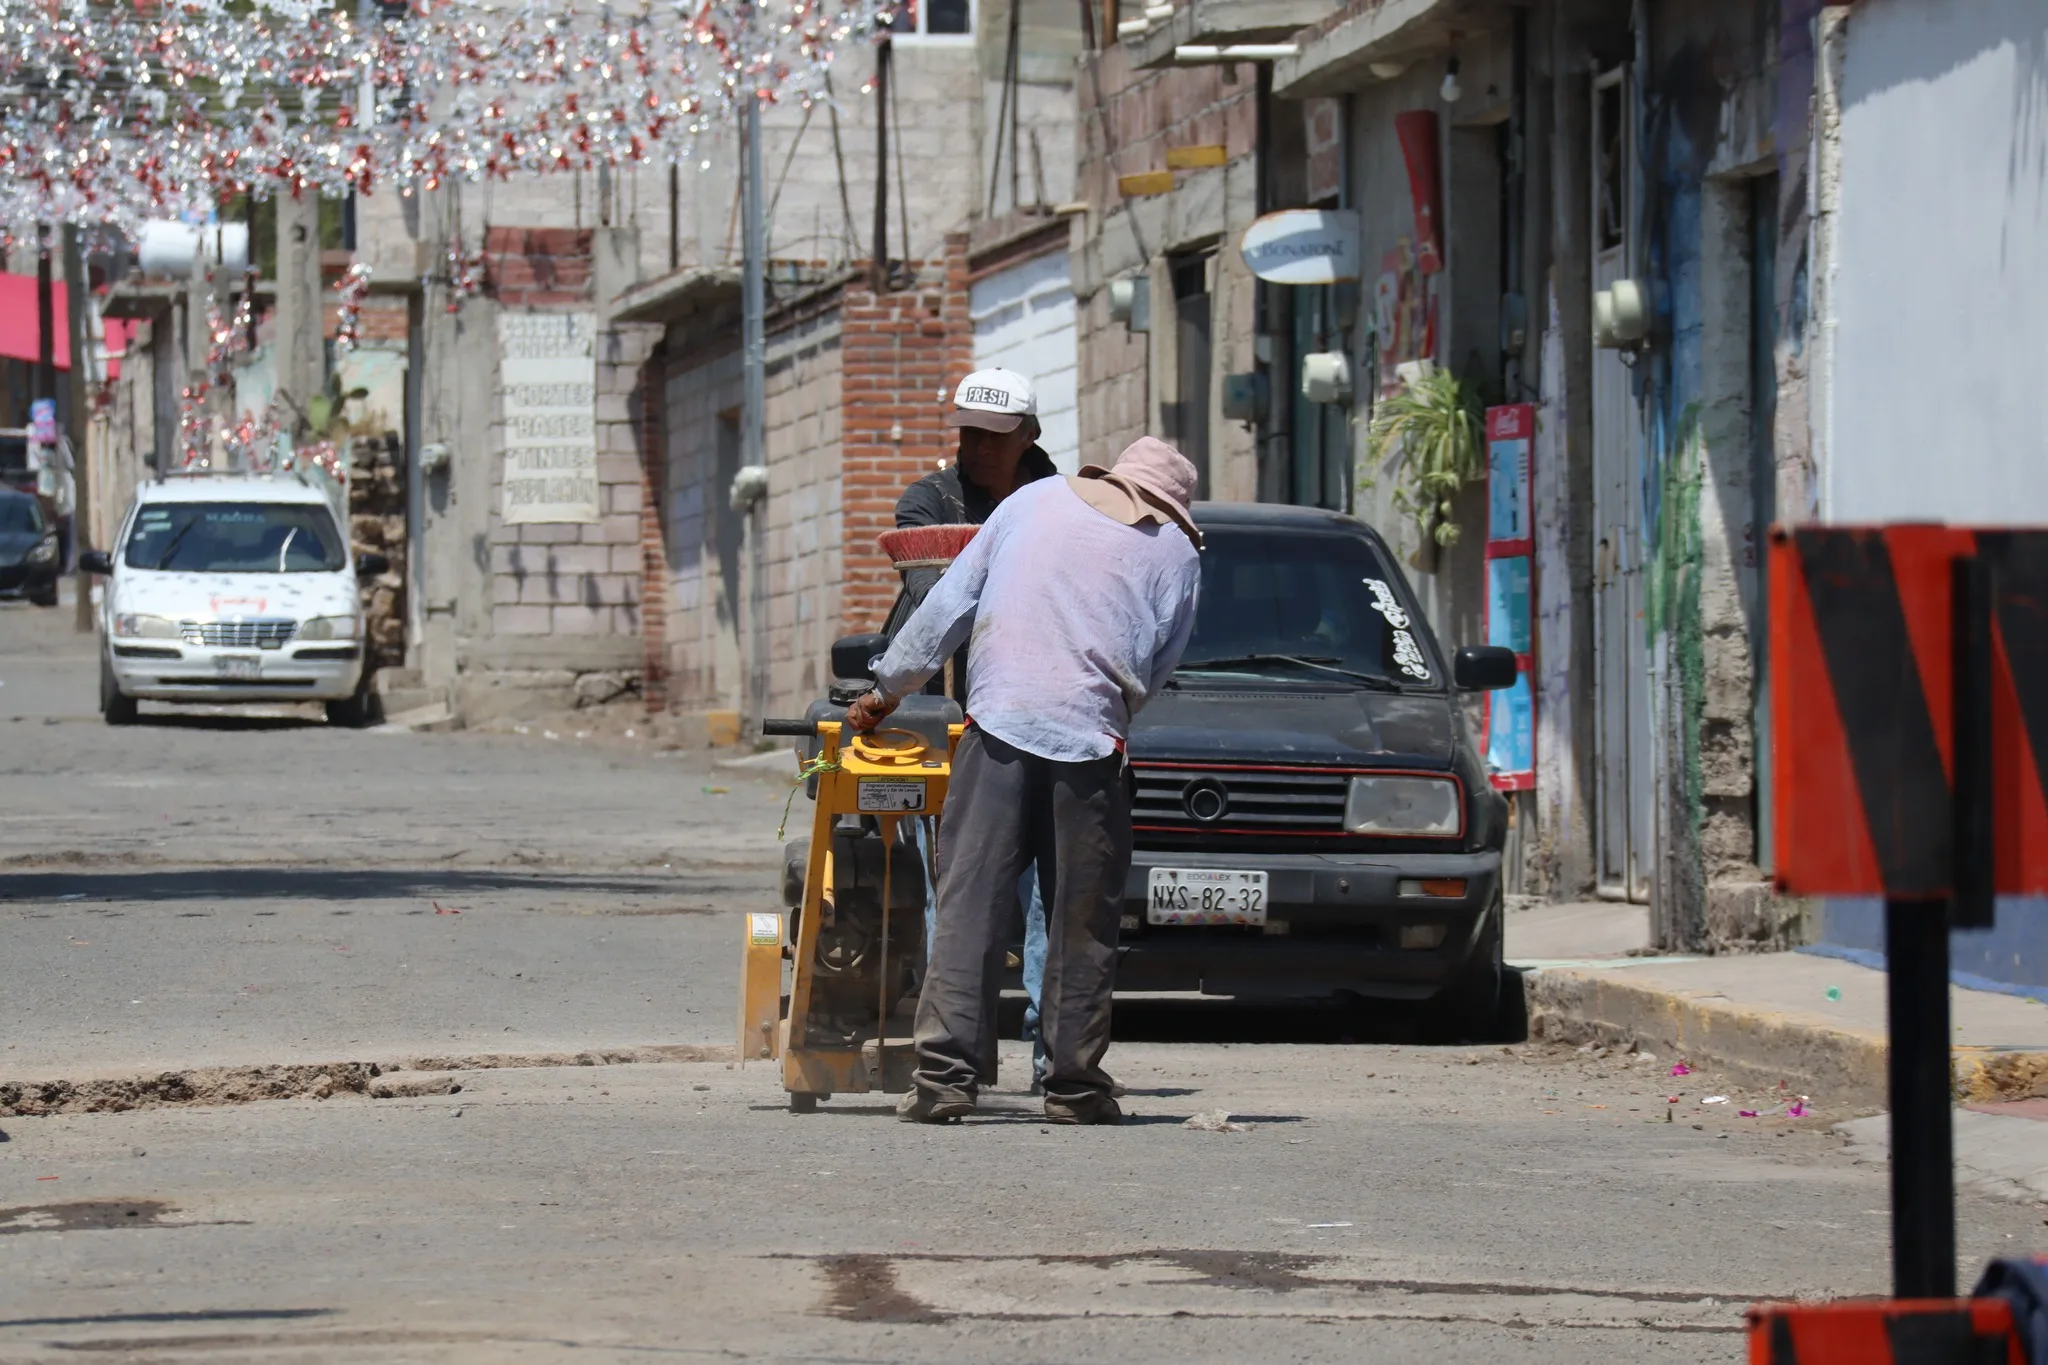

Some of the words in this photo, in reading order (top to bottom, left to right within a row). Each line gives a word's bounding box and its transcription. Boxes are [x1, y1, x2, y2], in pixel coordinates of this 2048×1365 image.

[967, 387, 1009, 406] FRESH
[516, 447, 595, 469] TINTES
[1152, 885, 1263, 912] NXS-82-32
